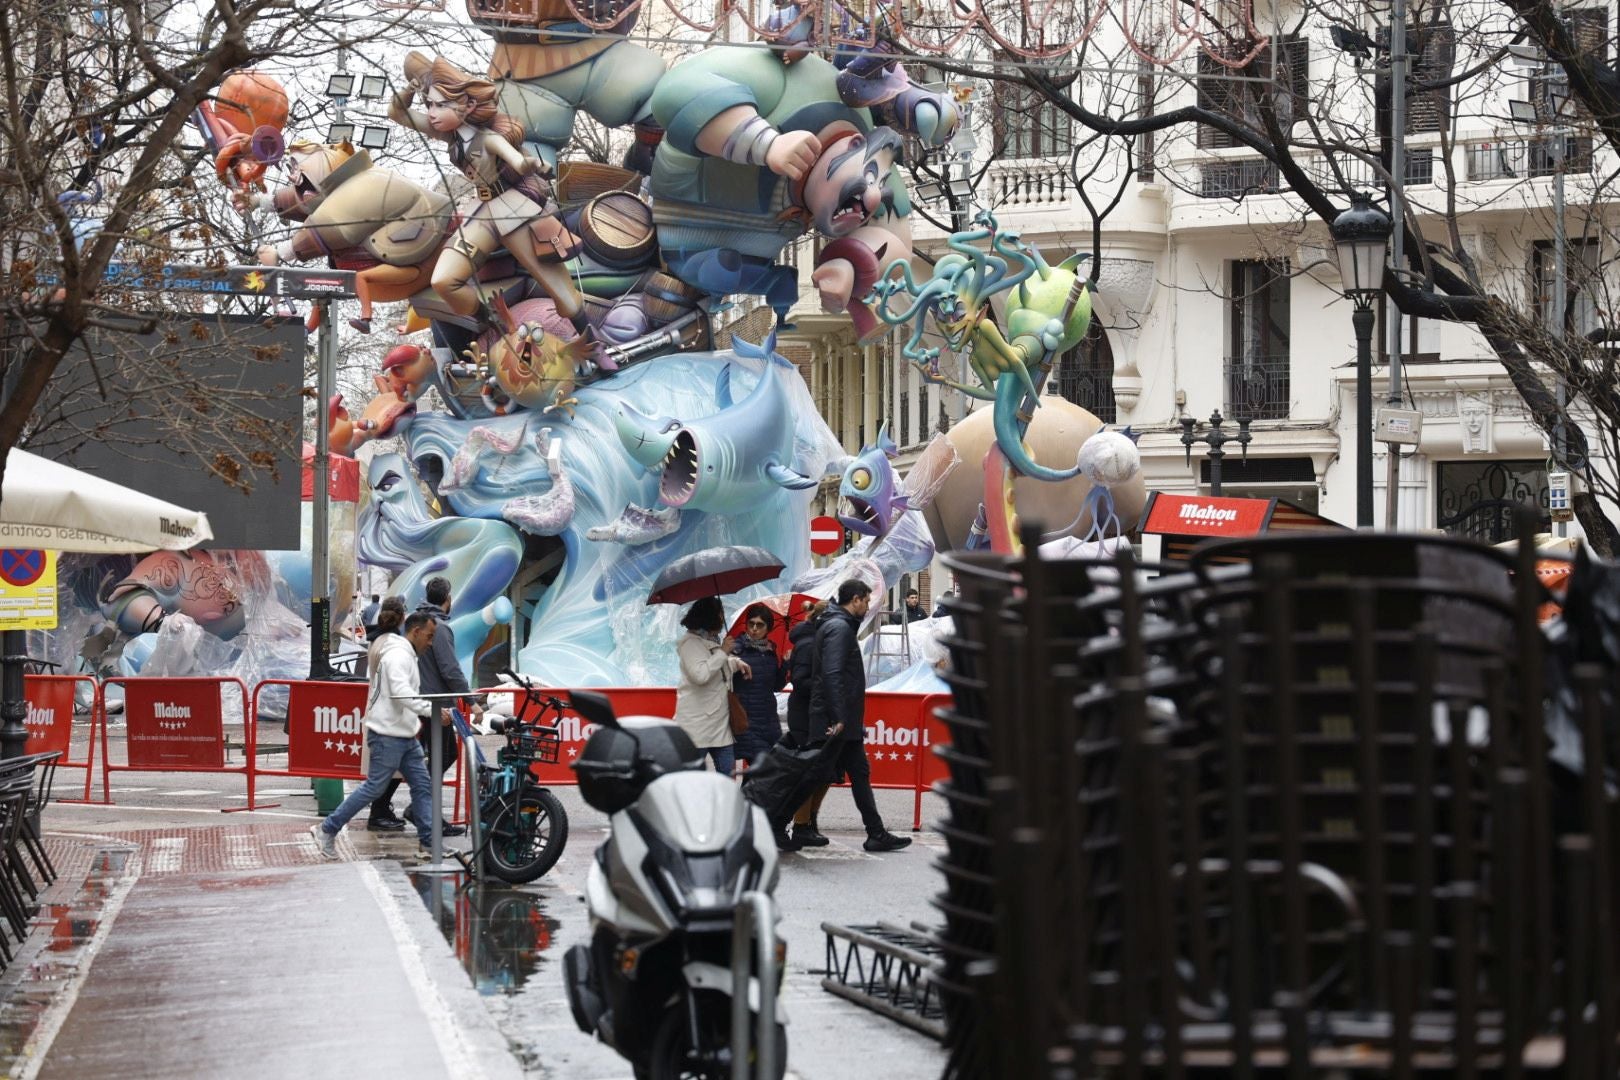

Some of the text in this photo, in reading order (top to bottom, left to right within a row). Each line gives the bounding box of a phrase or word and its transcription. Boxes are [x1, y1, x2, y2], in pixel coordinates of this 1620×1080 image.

[164, 279, 233, 292] ESPECIAL
[1179, 503, 1237, 521] Mahou
[22, 701, 55, 726] hou
[154, 702, 191, 718] Mahou
